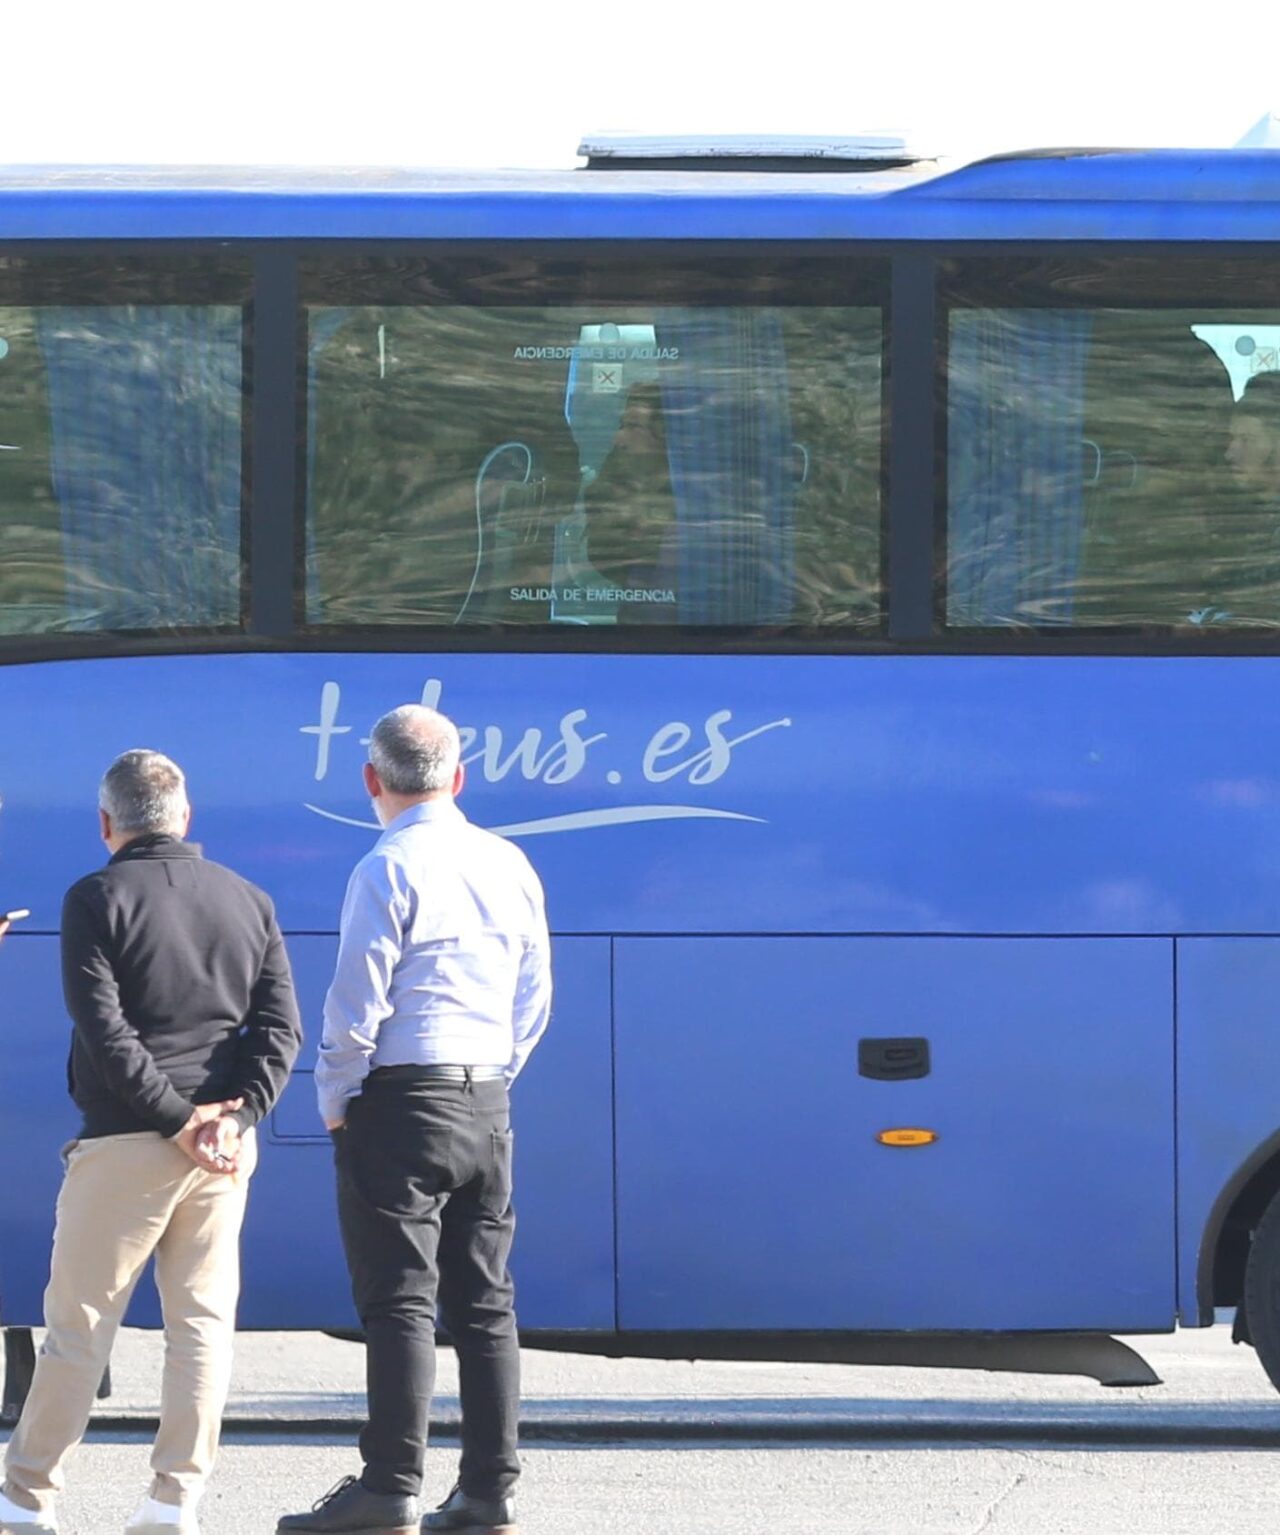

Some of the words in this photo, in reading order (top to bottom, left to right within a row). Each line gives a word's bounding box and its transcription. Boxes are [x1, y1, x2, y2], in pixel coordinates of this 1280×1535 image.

[510, 587, 558, 601] SALIDA
[563, 588, 582, 601] DE
[586, 589, 676, 602] EMERGENCIA
